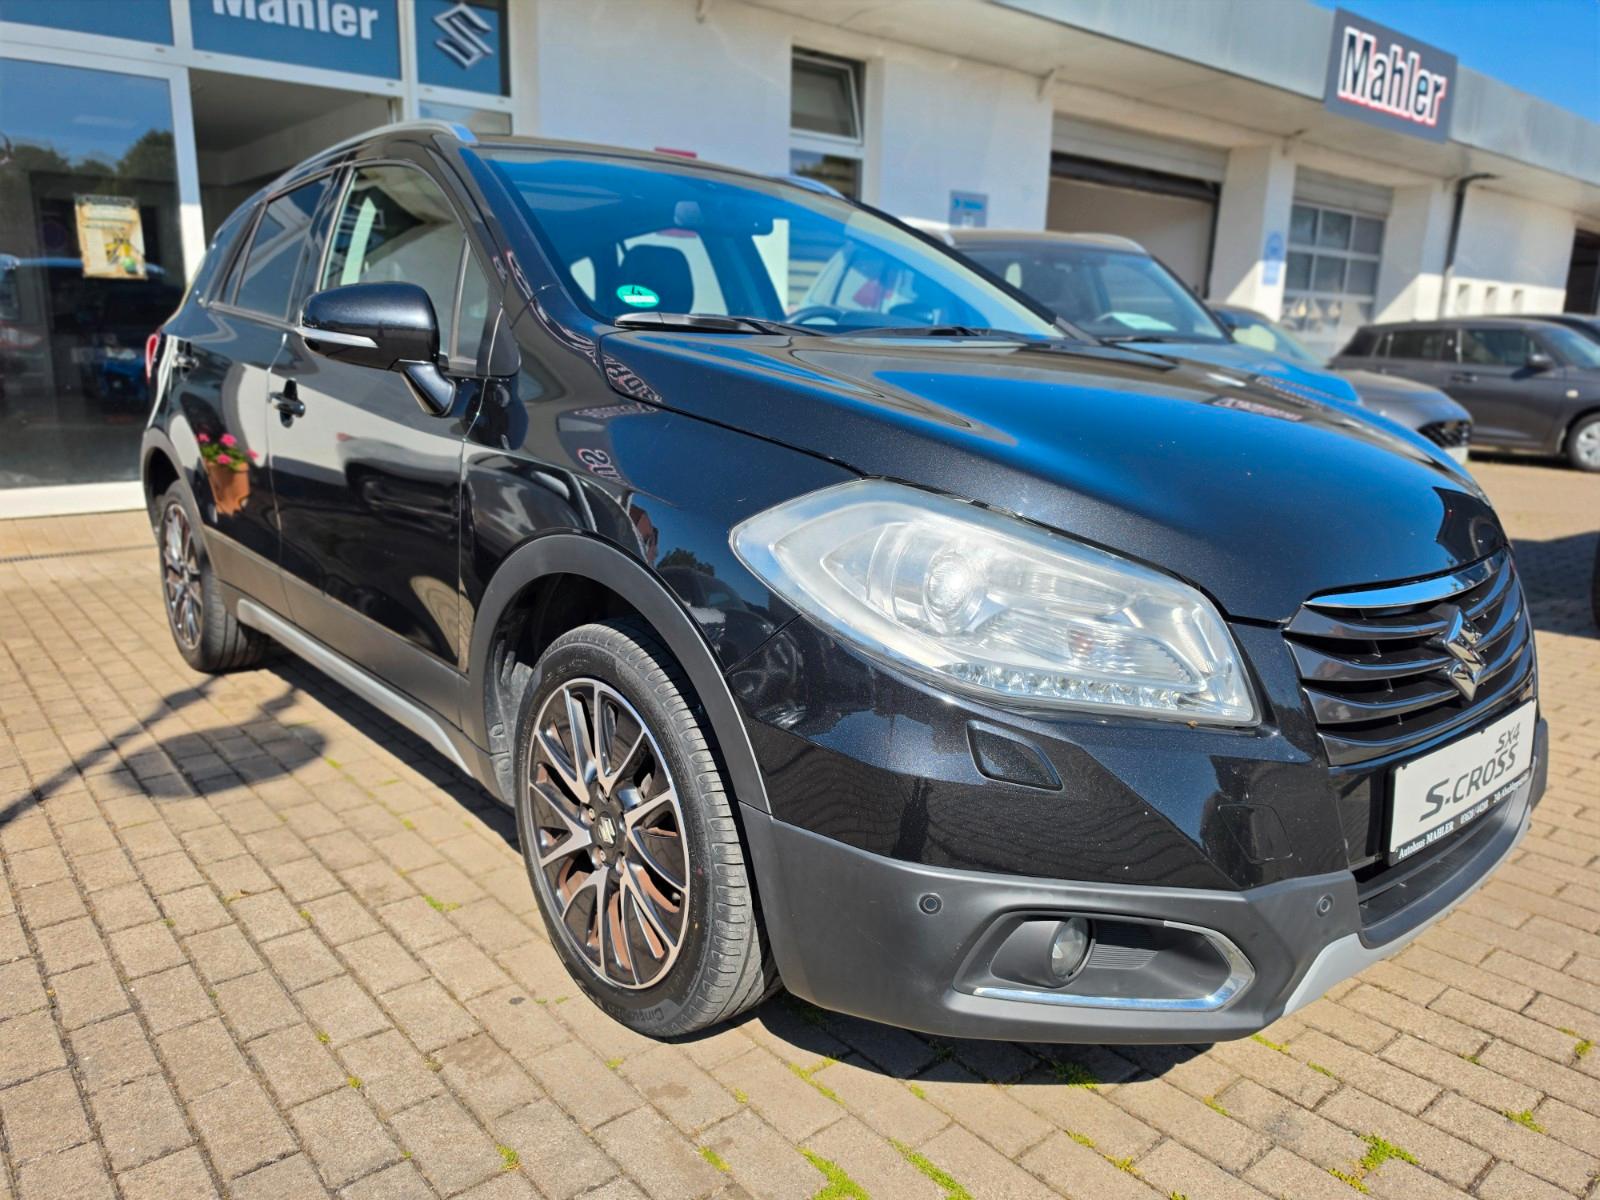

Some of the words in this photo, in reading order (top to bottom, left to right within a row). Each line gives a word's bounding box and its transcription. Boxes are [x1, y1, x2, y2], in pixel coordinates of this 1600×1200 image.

[1337, 25, 1447, 127] Mahler
[1495, 722, 1520, 753] SX4
[1426, 821, 1454, 844] MAHLER
